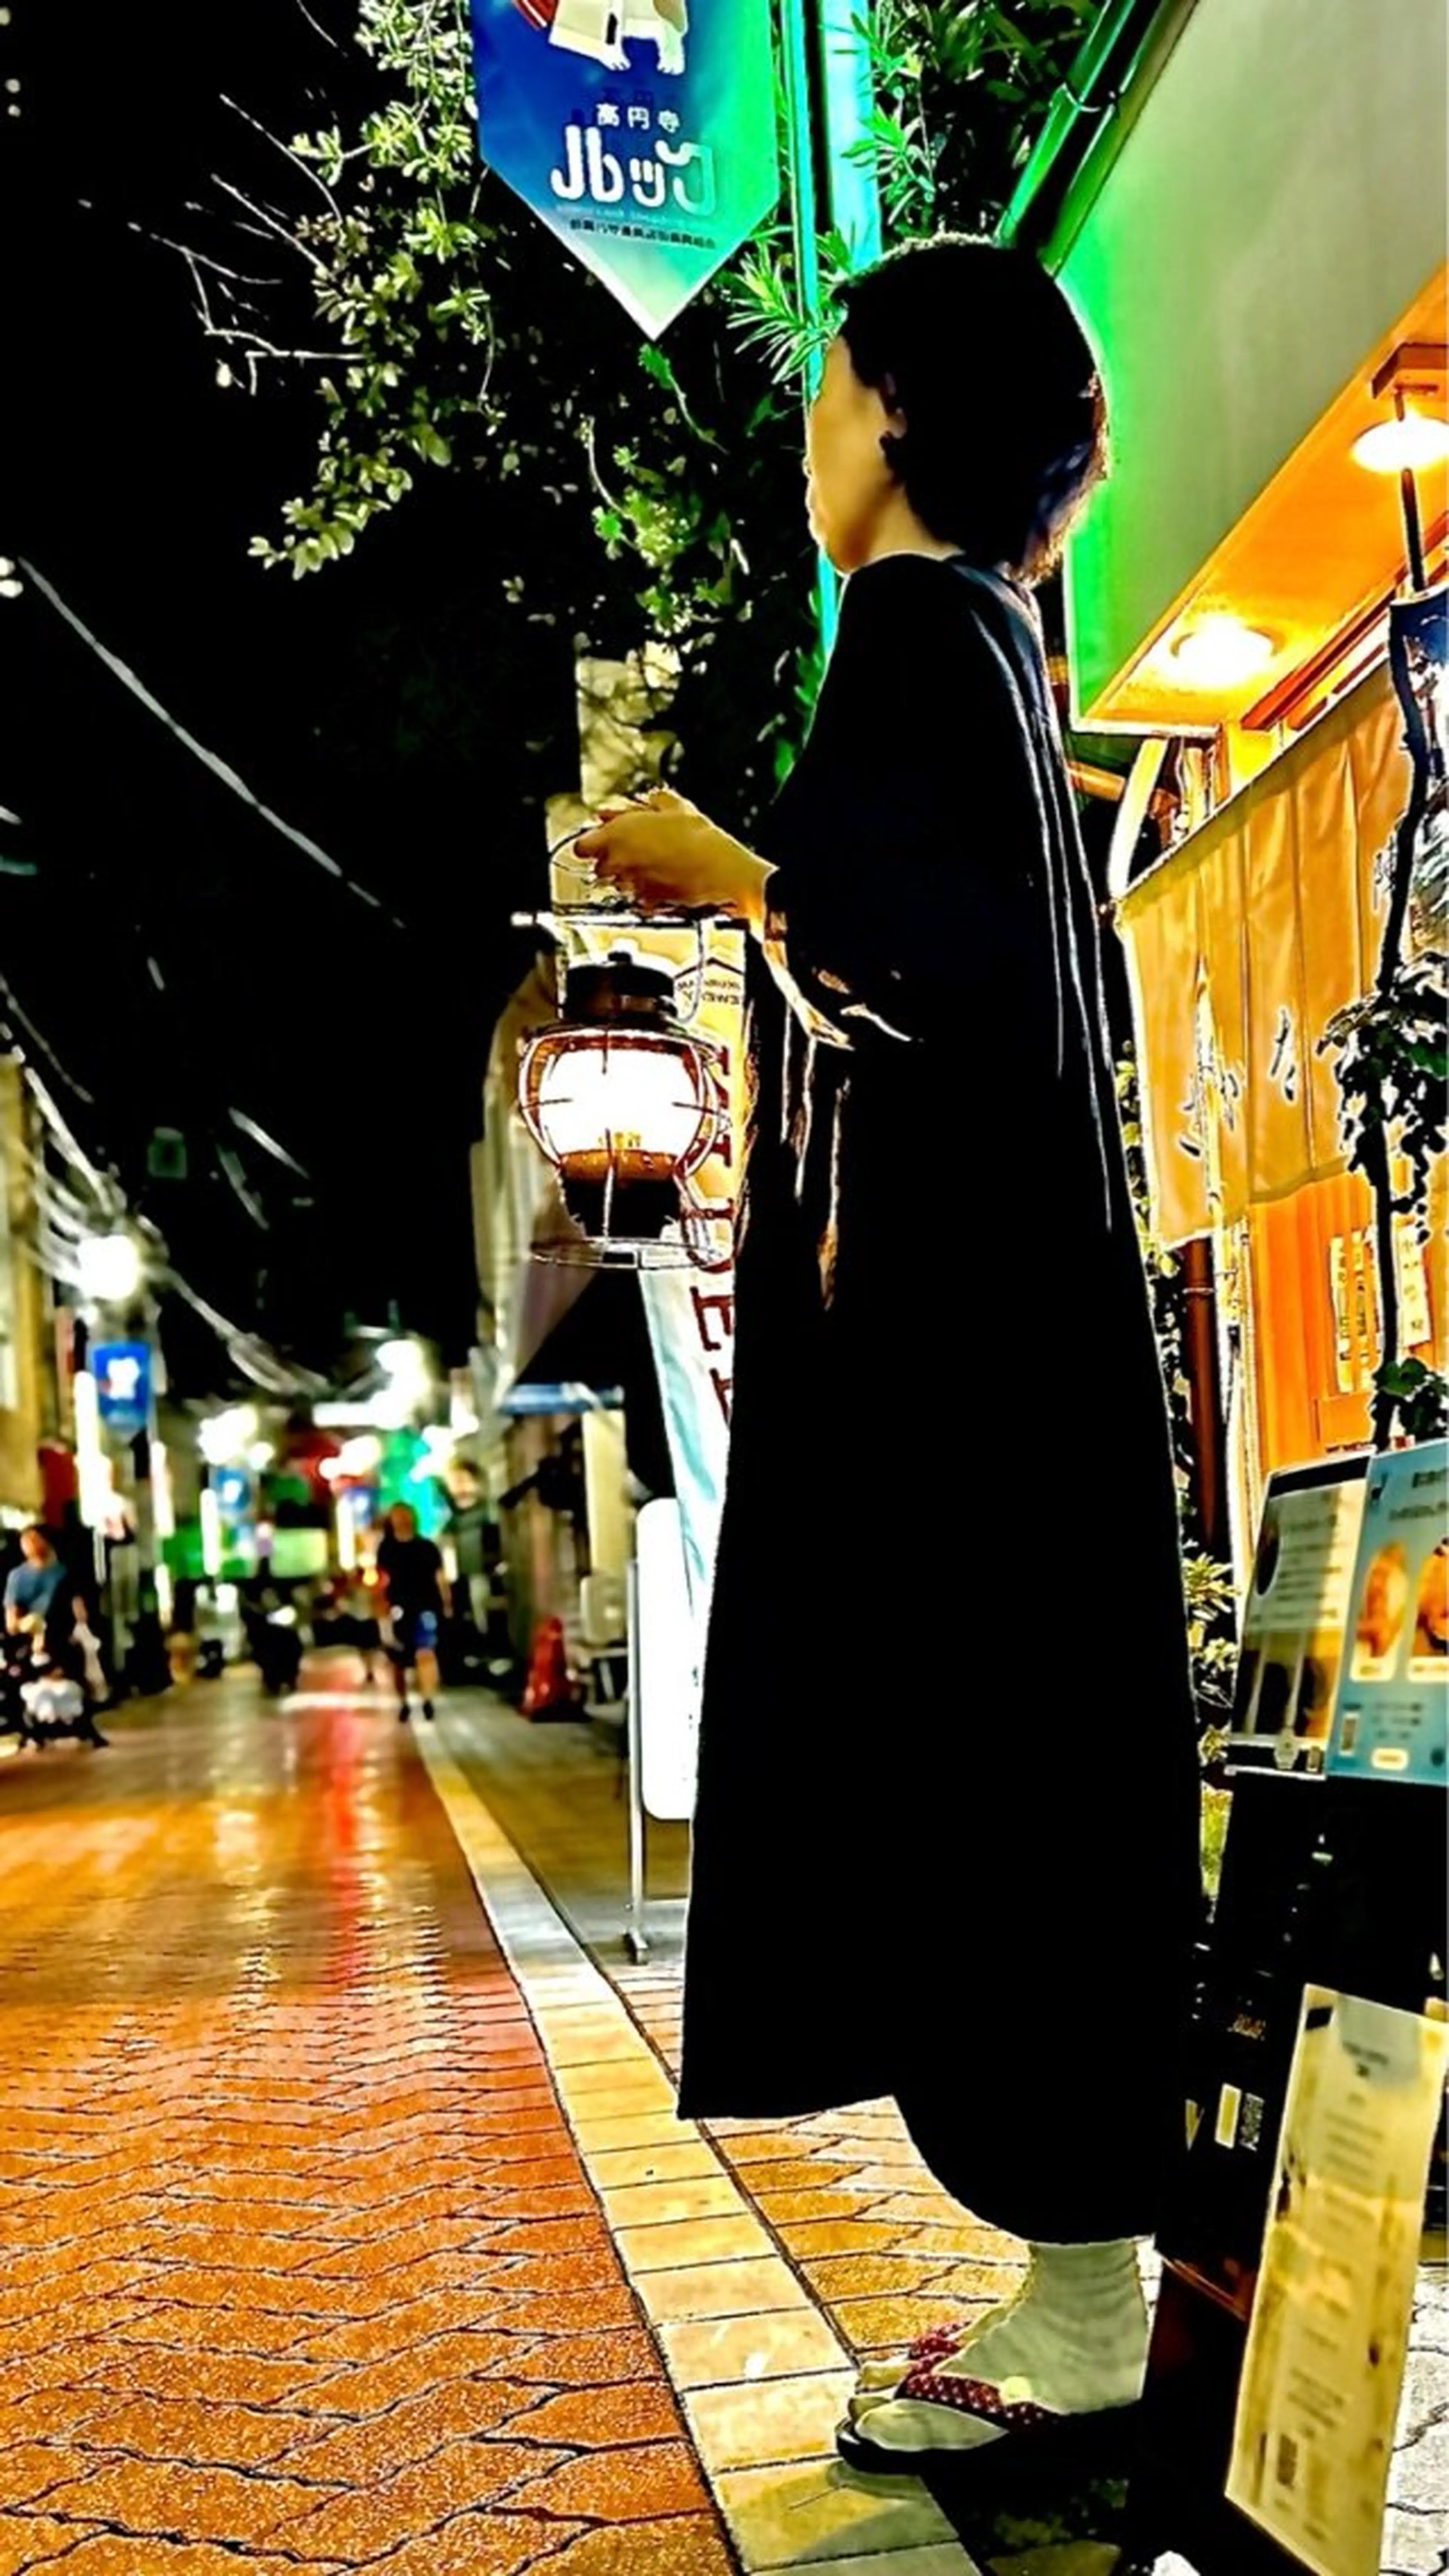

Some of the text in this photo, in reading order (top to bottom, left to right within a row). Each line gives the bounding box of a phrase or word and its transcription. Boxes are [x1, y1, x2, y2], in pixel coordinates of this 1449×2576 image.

[595, 103, 680, 133] 高円寺
[551, 124, 716, 216] ルック
